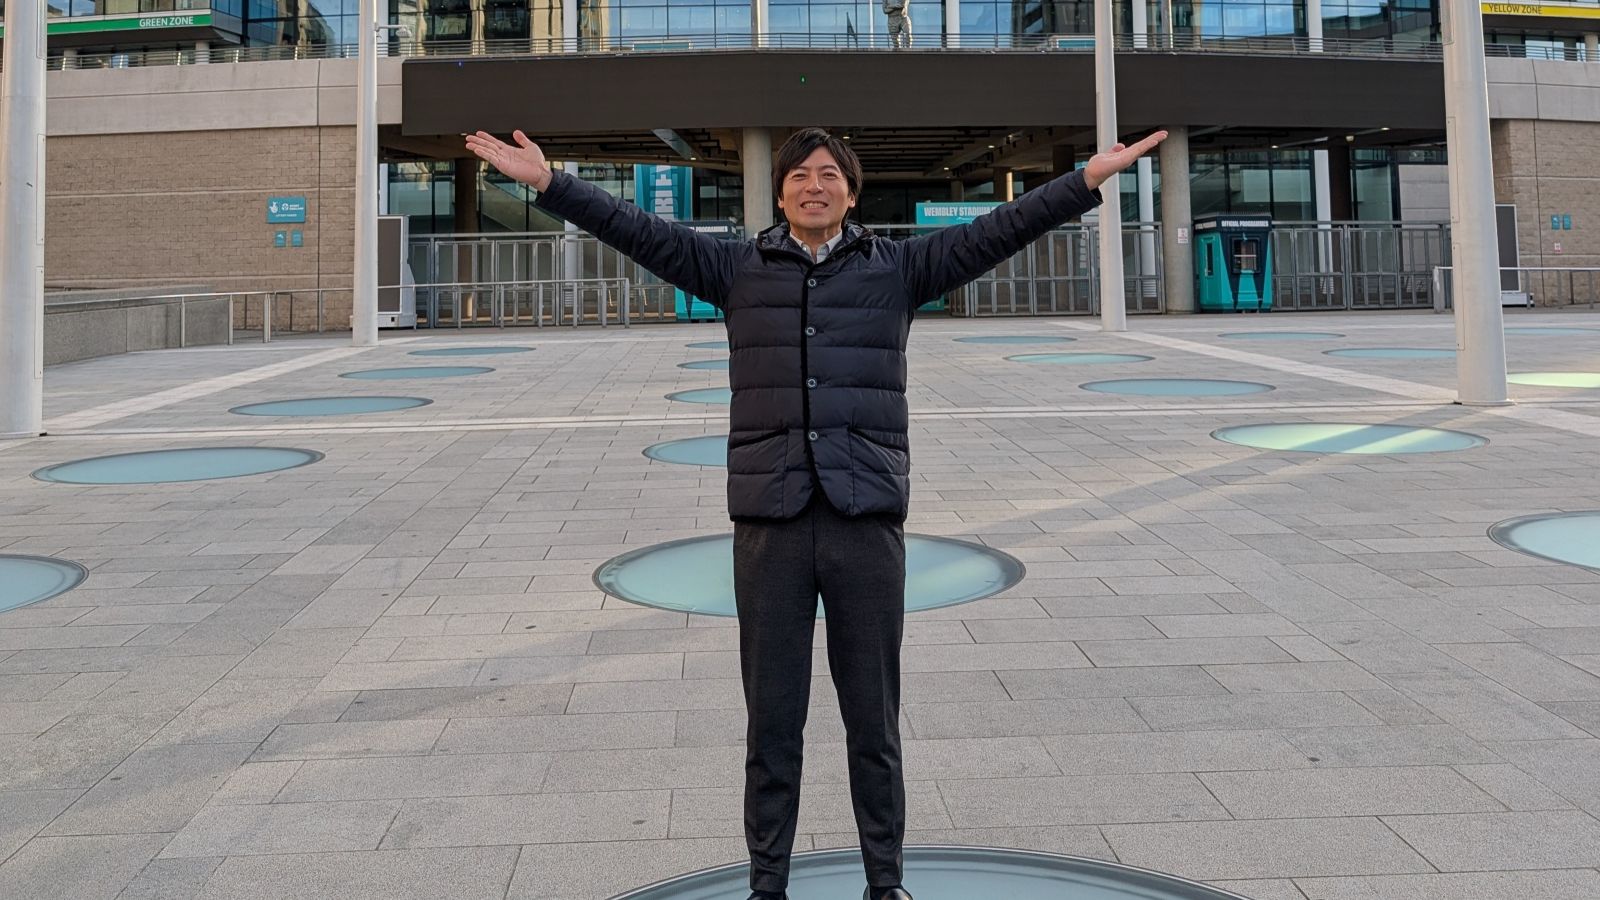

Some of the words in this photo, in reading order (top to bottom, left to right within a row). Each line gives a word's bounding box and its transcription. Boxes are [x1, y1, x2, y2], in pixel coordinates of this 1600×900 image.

[1488, 3, 1520, 13] YELLOW
[1521, 5, 1543, 14] ZONE
[139, 18, 168, 27] GREEN
[168, 16, 194, 26] ZONE
[924, 206, 958, 217] WEMBLEY
